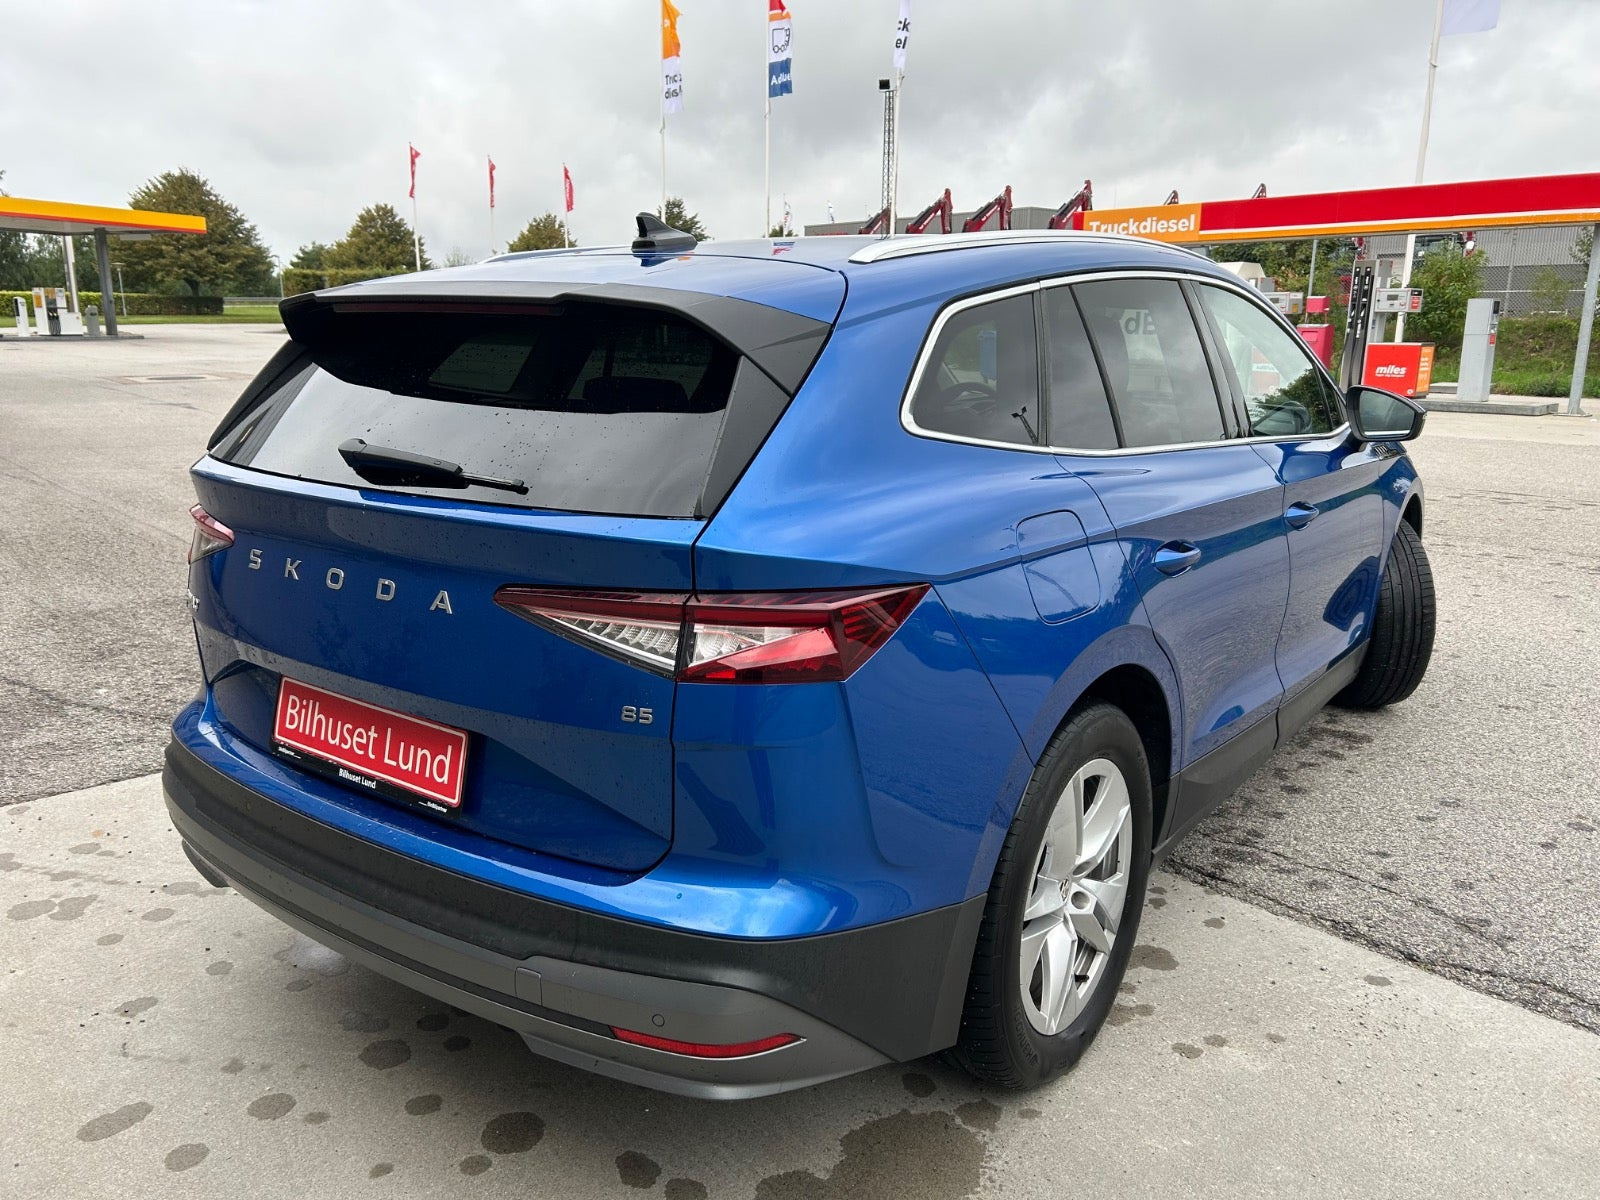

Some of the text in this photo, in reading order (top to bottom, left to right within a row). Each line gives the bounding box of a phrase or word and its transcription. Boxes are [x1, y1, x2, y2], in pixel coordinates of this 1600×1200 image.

[1088, 213, 1196, 235] Truckdiesel
[1375, 364, 1407, 375] miles
[621, 705, 653, 725] 85
[285, 694, 453, 785] Bilhuset Lund
[338, 768, 377, 790] Bilhuset Lund
